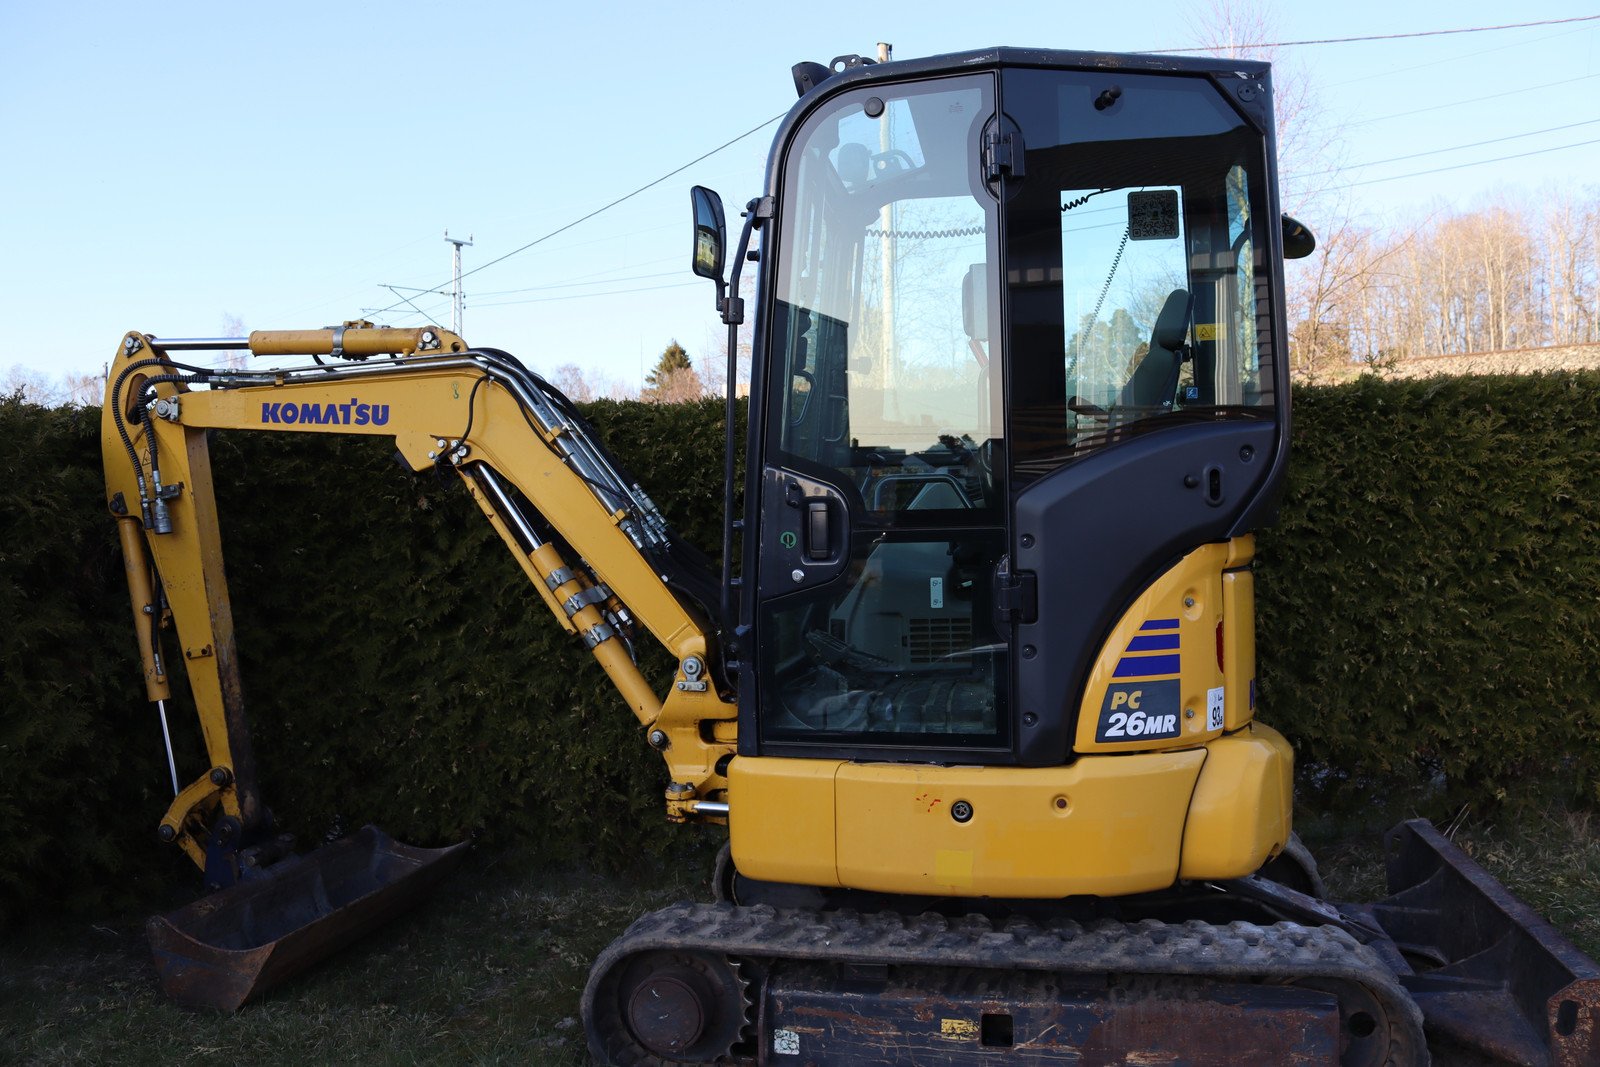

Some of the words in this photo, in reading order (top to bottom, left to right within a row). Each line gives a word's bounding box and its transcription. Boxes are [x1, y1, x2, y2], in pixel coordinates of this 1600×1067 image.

[262, 398, 389, 425] KOMATSU
[1110, 690, 1142, 710] PC
[1104, 711, 1176, 736] 26MR
